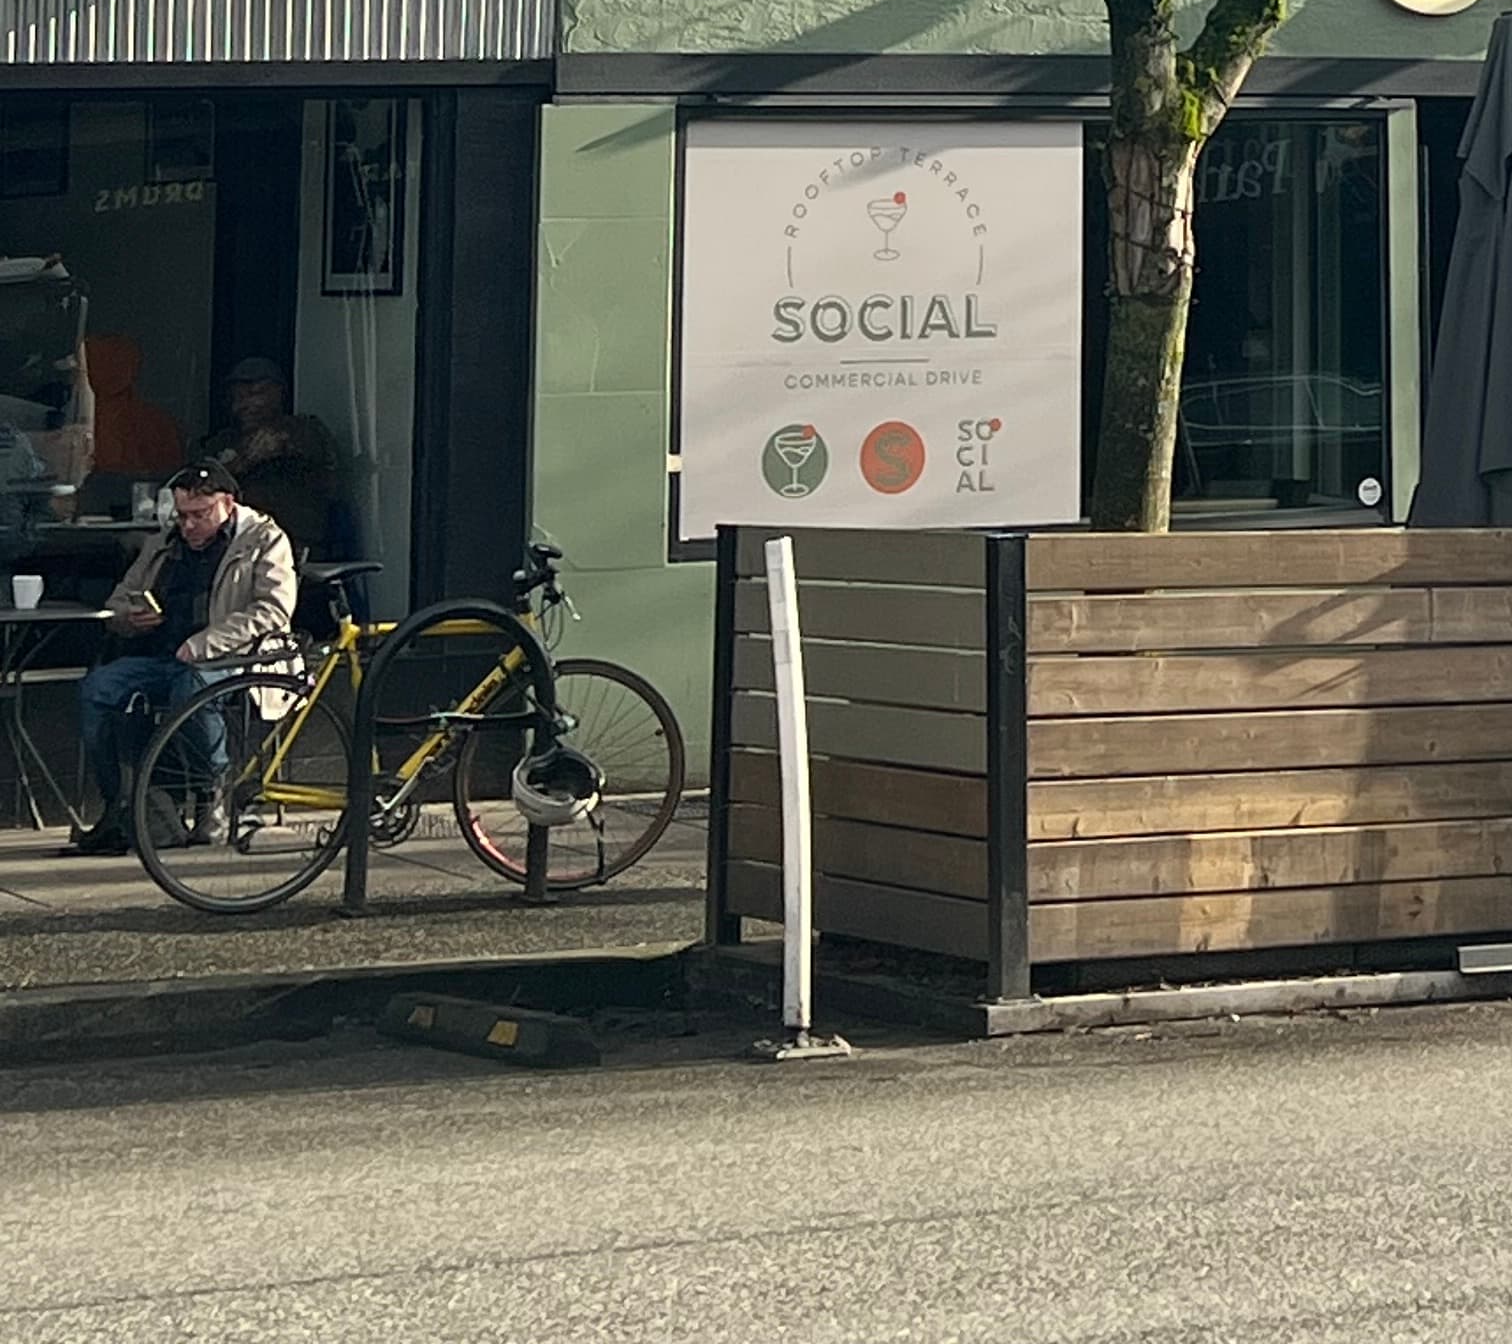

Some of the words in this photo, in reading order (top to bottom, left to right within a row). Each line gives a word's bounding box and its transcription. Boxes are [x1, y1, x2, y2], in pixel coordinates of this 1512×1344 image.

[783, 146, 882, 239] ROOFTOP
[899, 146, 987, 236] TERRACE
[771, 293, 998, 344] SOCIAL
[783, 370, 918, 390] COMMERCIAL
[926, 369, 983, 387] DRIVE
[956, 445, 988, 467] CI
[956, 469, 996, 493] AL
